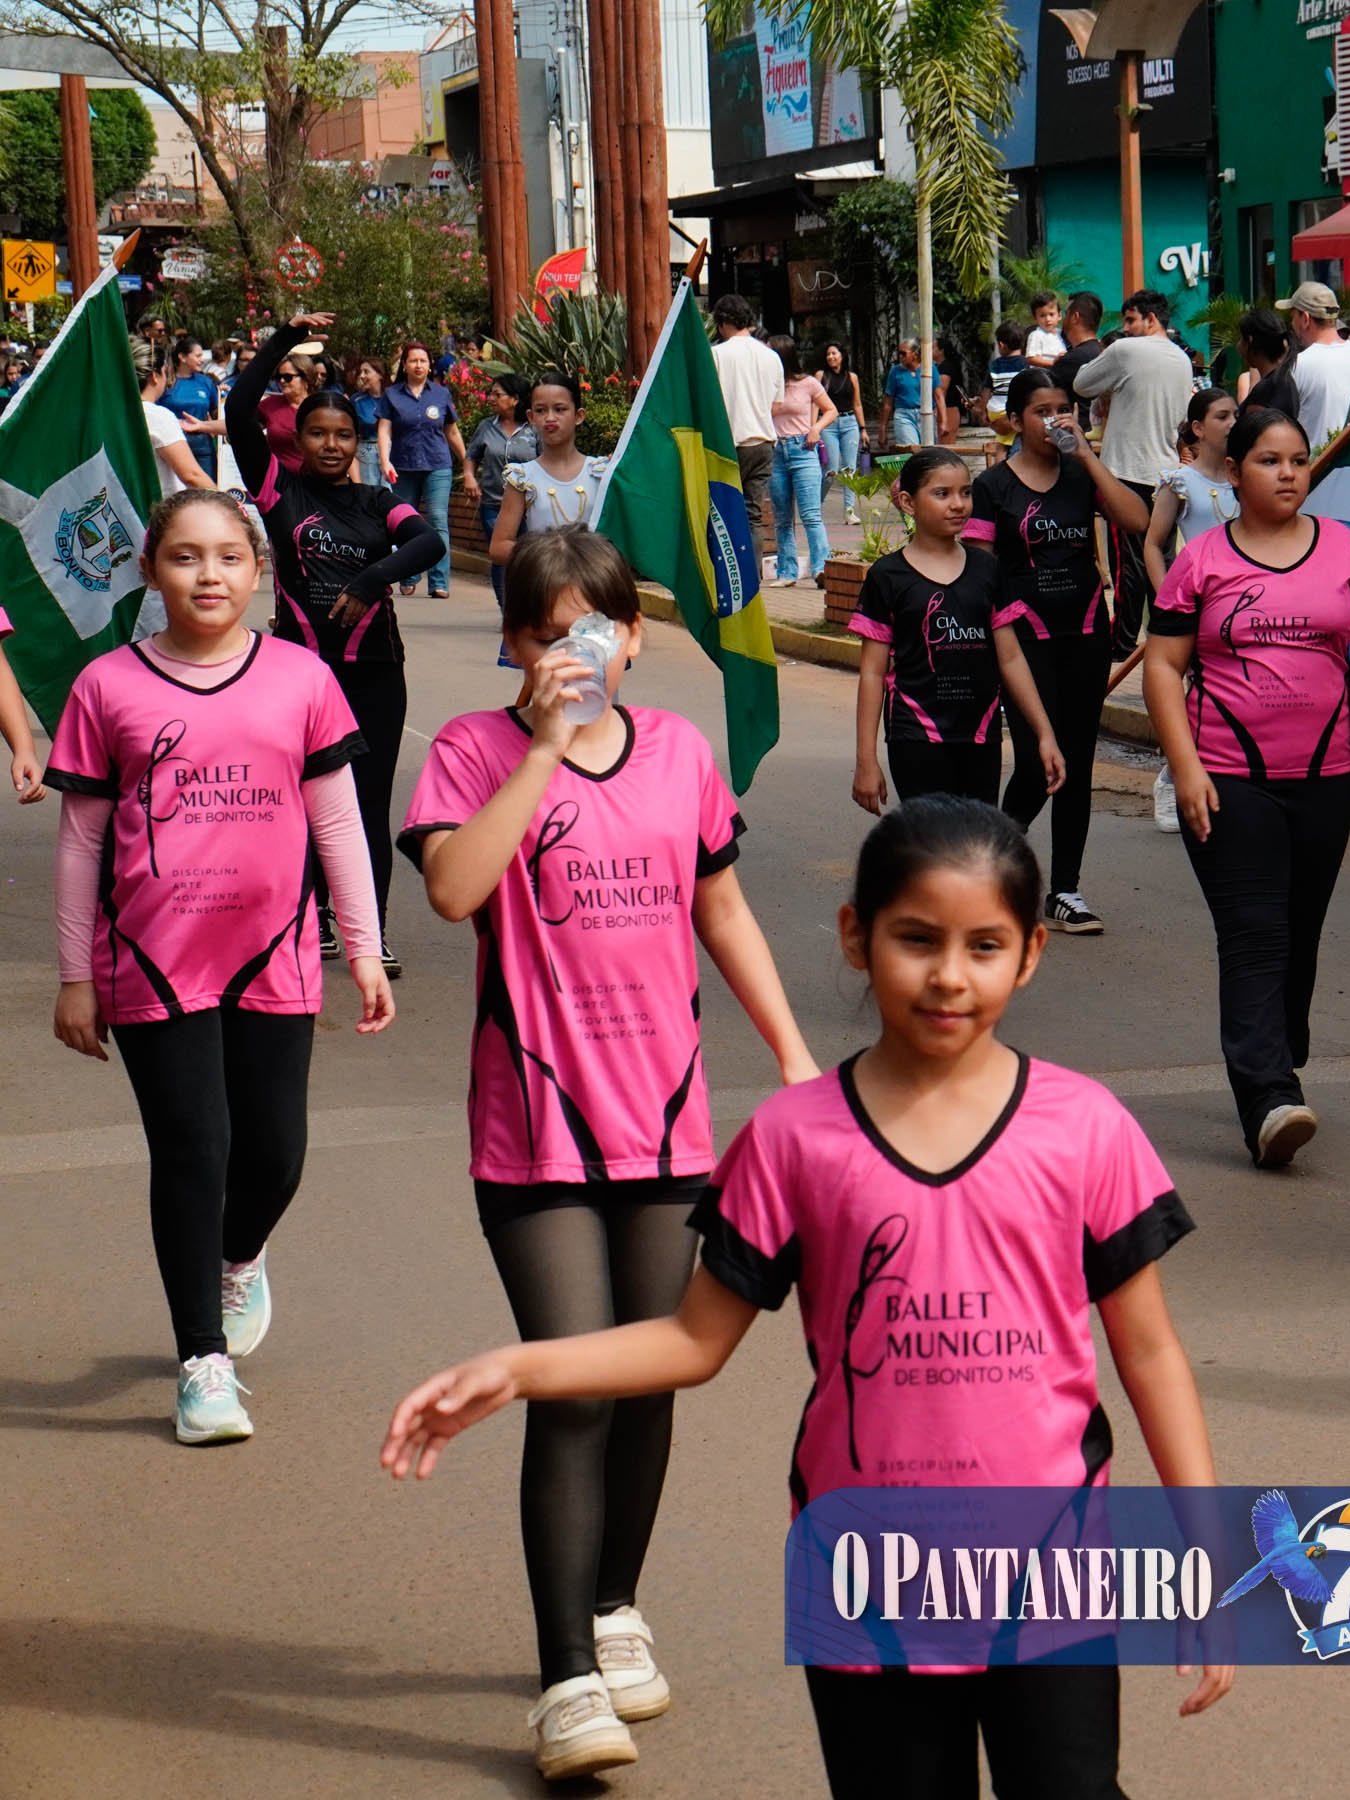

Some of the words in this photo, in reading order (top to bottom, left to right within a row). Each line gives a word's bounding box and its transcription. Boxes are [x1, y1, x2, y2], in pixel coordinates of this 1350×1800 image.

[764, 46, 808, 102] Figueira
[1067, 65, 1092, 85] SUCESSO
[1143, 59, 1174, 85] MULTI
[542, 271, 562, 283] AQUI
[564, 273, 581, 284] TEM
[309, 528, 332, 542] CIA
[1035, 519, 1058, 531] CIA
[58, 537, 94, 588] BONITO
[720, 533, 741, 601] PROGRESSO
[936, 616, 958, 629] CIA
[1250, 616, 1311, 629] BALLET
[949, 627, 986, 642] JUVENIL
[175, 765, 252, 787] BALLET
[178, 788, 284, 808] MUNICIPAL
[185, 813, 202, 824] DE
[205, 811, 255, 823] BONITO
[258, 811, 274, 822] MS
[172, 868, 239, 877] DISCIPLINA
[567, 857, 651, 882] BALLET
[574, 885, 683, 909] MUNICIPAL
[172, 904, 244, 915] TRANSFORMA
[582, 917, 602, 930] DE
[606, 914, 658, 928] BONITO
[885, 1291, 992, 1322] BALLET
[885, 1329, 1047, 1360] MUNICIPAL
[894, 1368, 921, 1387] DE
[926, 1366, 1003, 1385] BONITO
[1008, 1365, 1035, 1382] MS
[878, 1460, 980, 1472] DISCIPLINA
